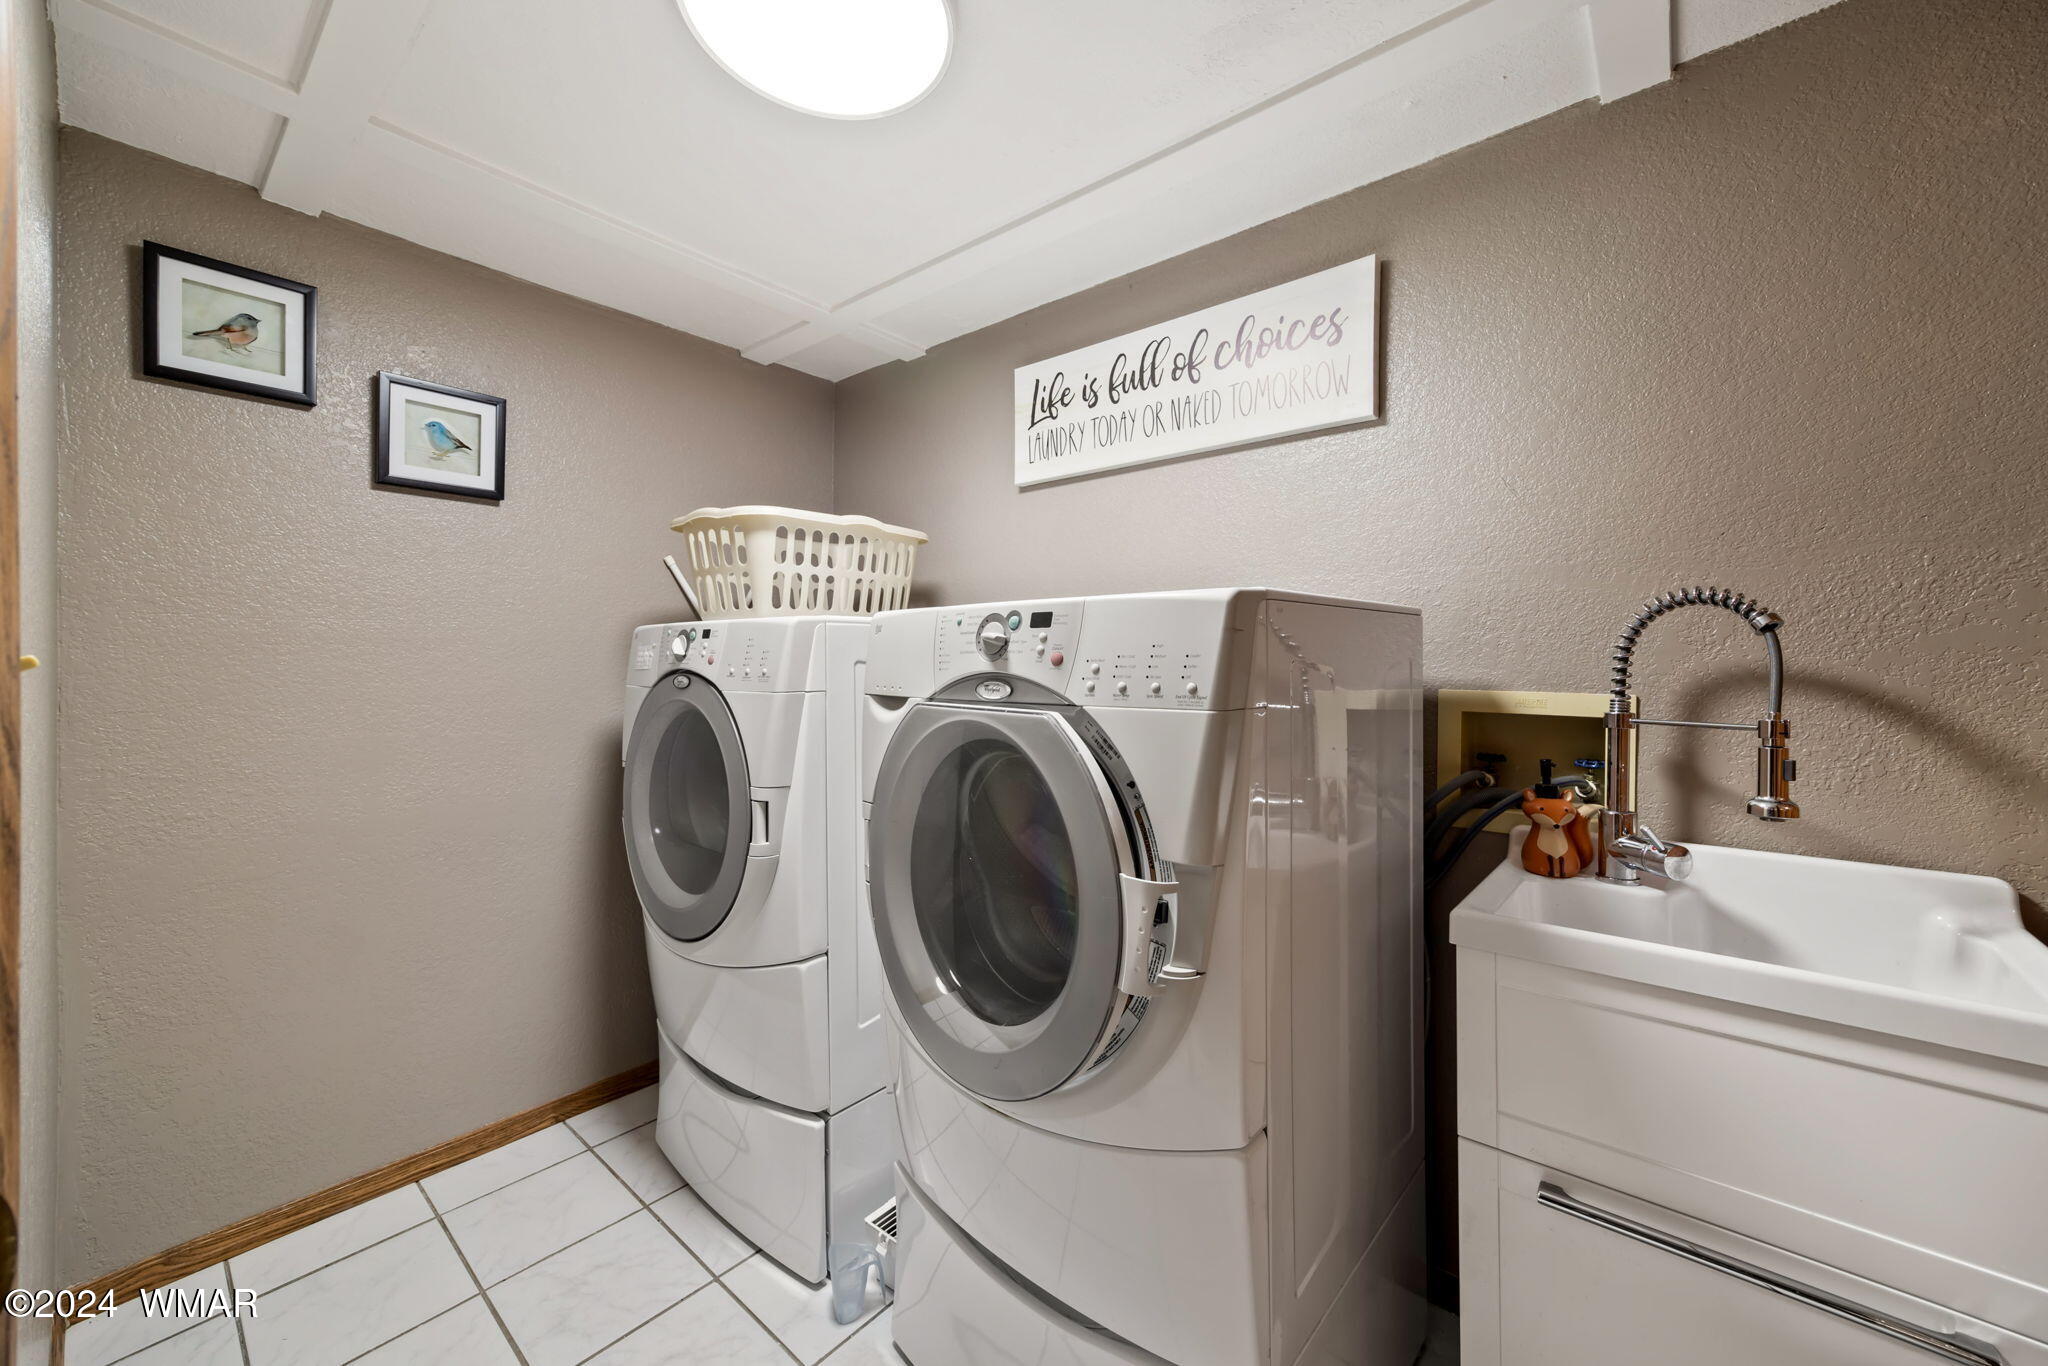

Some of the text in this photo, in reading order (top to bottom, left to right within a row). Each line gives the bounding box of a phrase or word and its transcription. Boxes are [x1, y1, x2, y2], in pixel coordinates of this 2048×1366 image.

[1028, 307, 1349, 430] Life is full of choices
[1028, 354, 1351, 464] LAUNDRY TODAY OR NAKED TOMORROW
